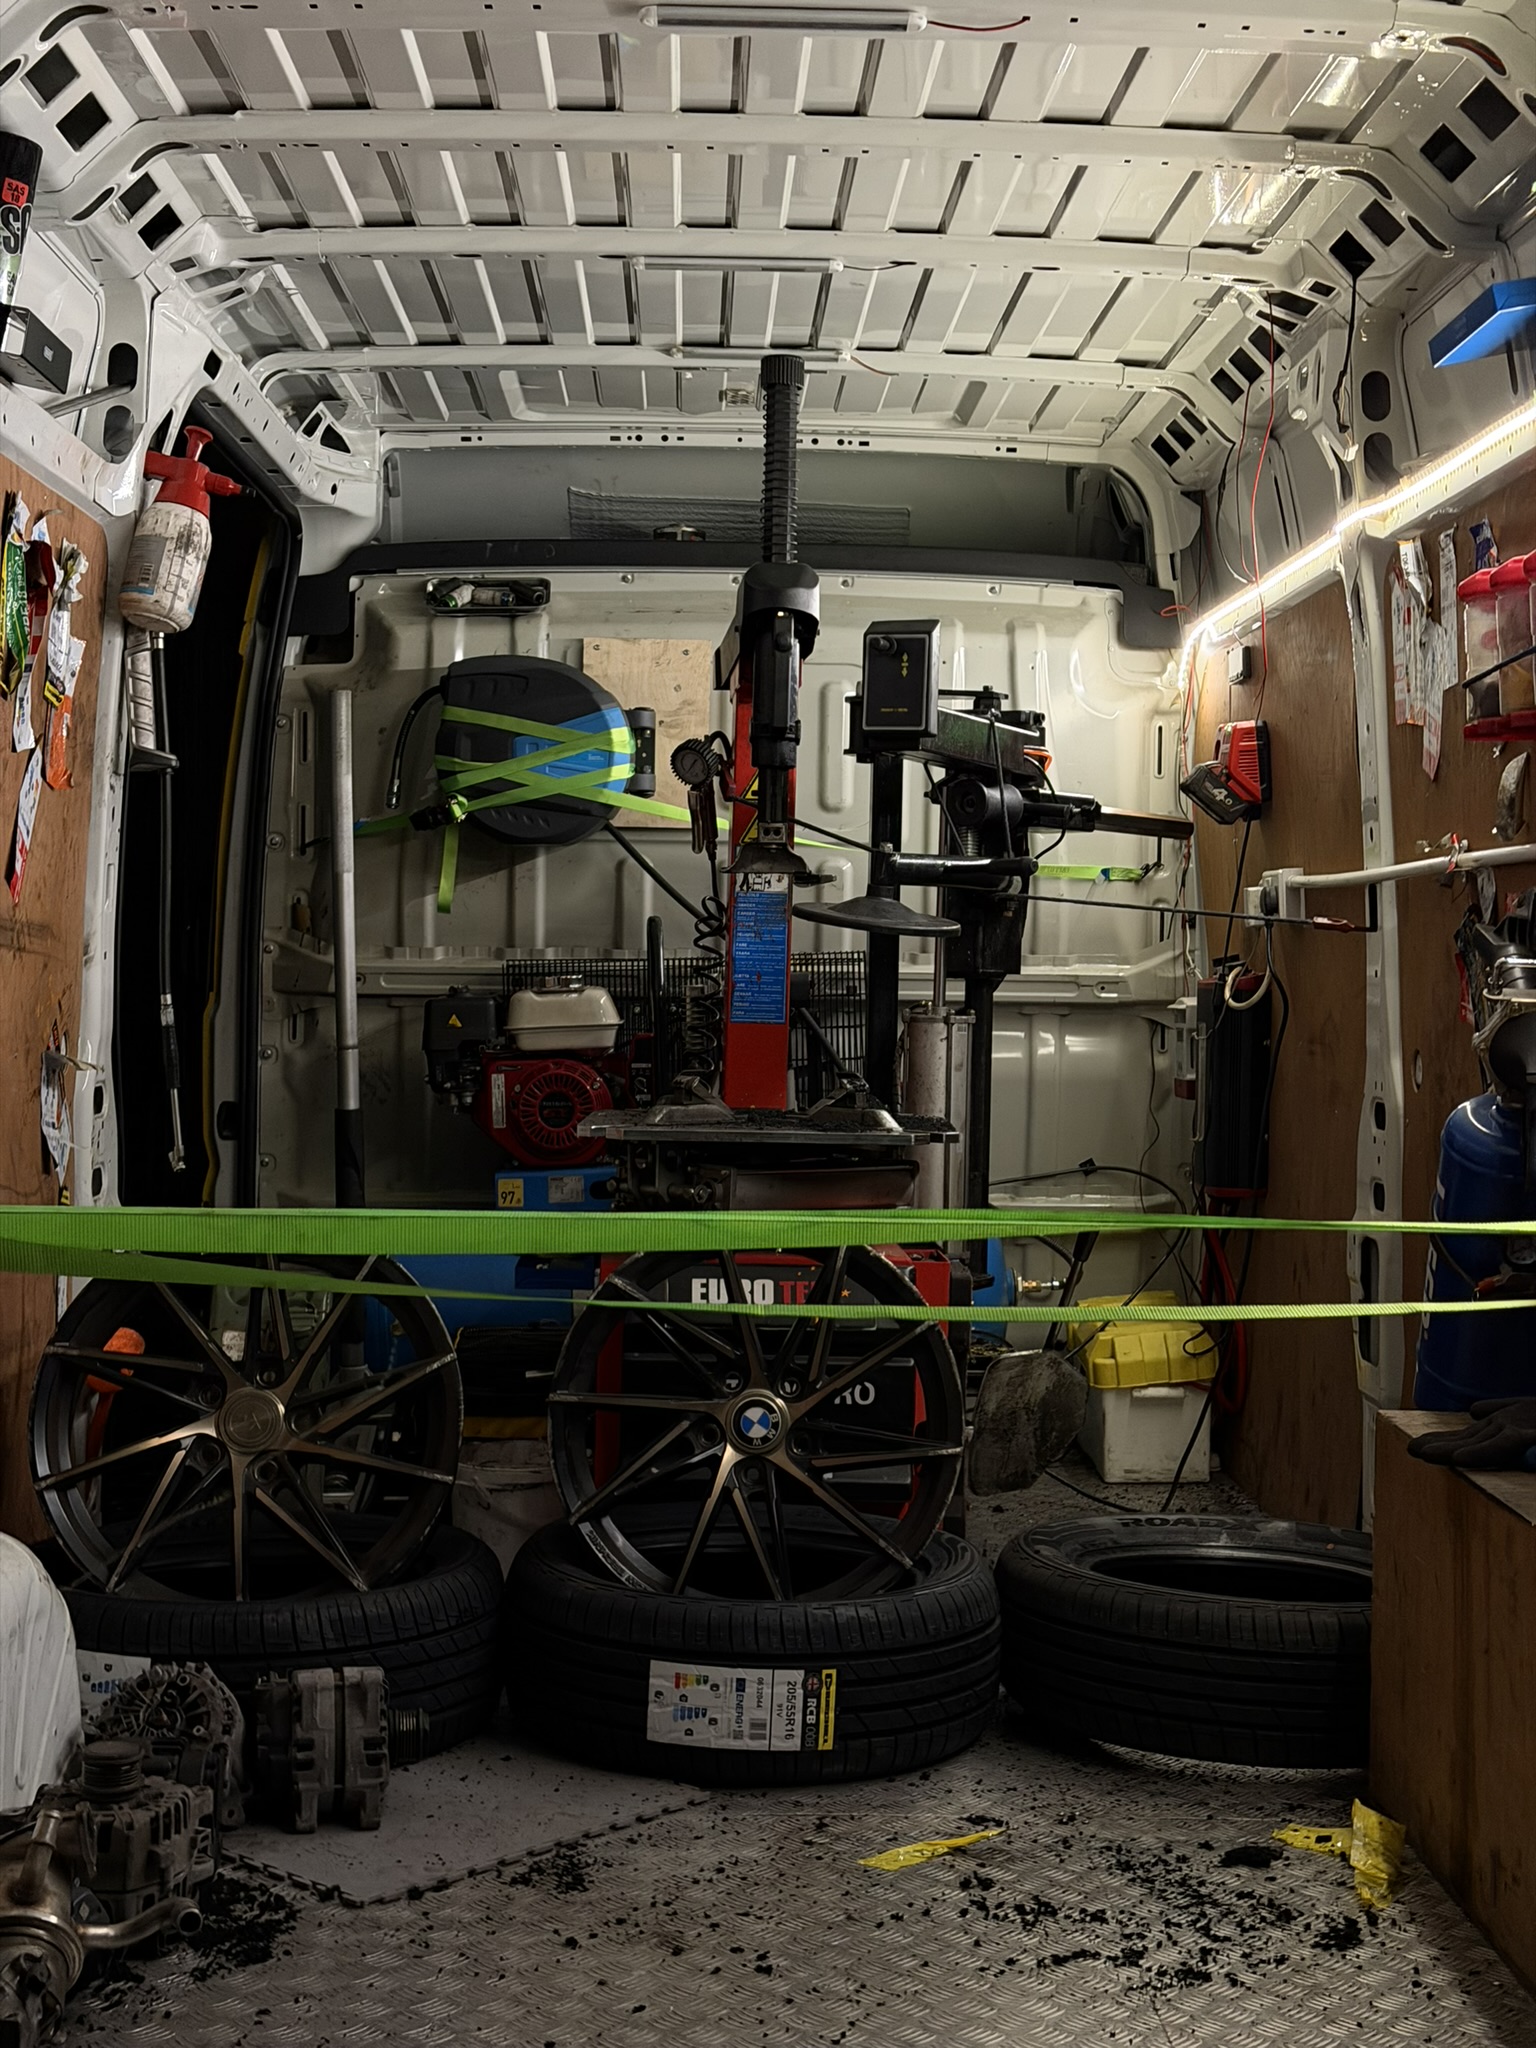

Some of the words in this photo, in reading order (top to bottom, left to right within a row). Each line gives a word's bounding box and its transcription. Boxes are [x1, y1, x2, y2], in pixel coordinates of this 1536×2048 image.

[7, 181, 26, 196] SAS
[10, 192, 21, 204] 18
[501, 1191, 515, 1205] 97
[752, 1412, 779, 1447] BMW
[784, 1680, 797, 1742] 205/55R16
[805, 1697, 817, 1725] RCB
